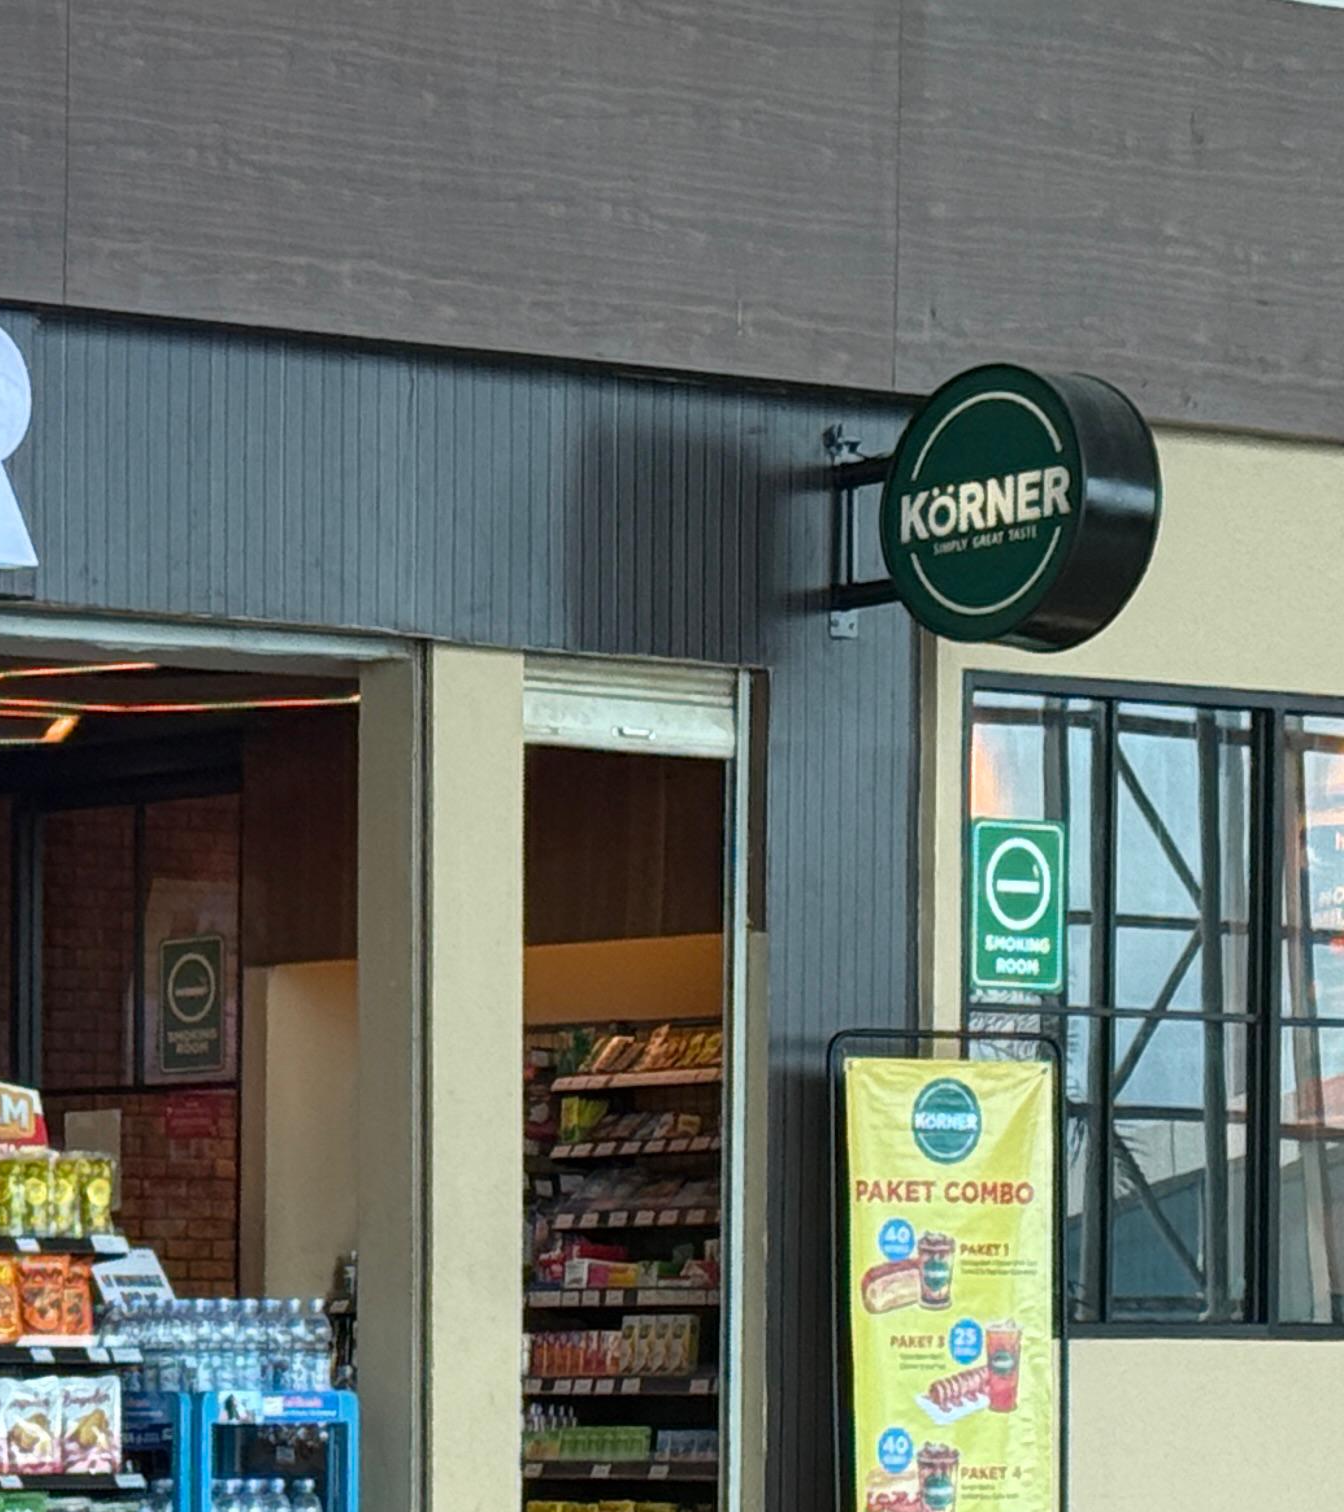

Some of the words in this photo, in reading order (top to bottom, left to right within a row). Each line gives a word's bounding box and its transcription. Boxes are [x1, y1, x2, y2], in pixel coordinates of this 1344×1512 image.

[900, 466, 1072, 544] KÖRNER
[972, 531, 1004, 549] GREAT
[1008, 526, 1037, 543] TASTE
[985, 934, 1051, 954] SMOKING
[996, 957, 1040, 975] ROOM
[855, 1180, 936, 1203] PAKET
[944, 1181, 1035, 1204] COMBO
[960, 1243, 1001, 1257] PAKET
[882, 1435, 909, 1455] 40
[961, 1466, 1008, 1481] PAKET
